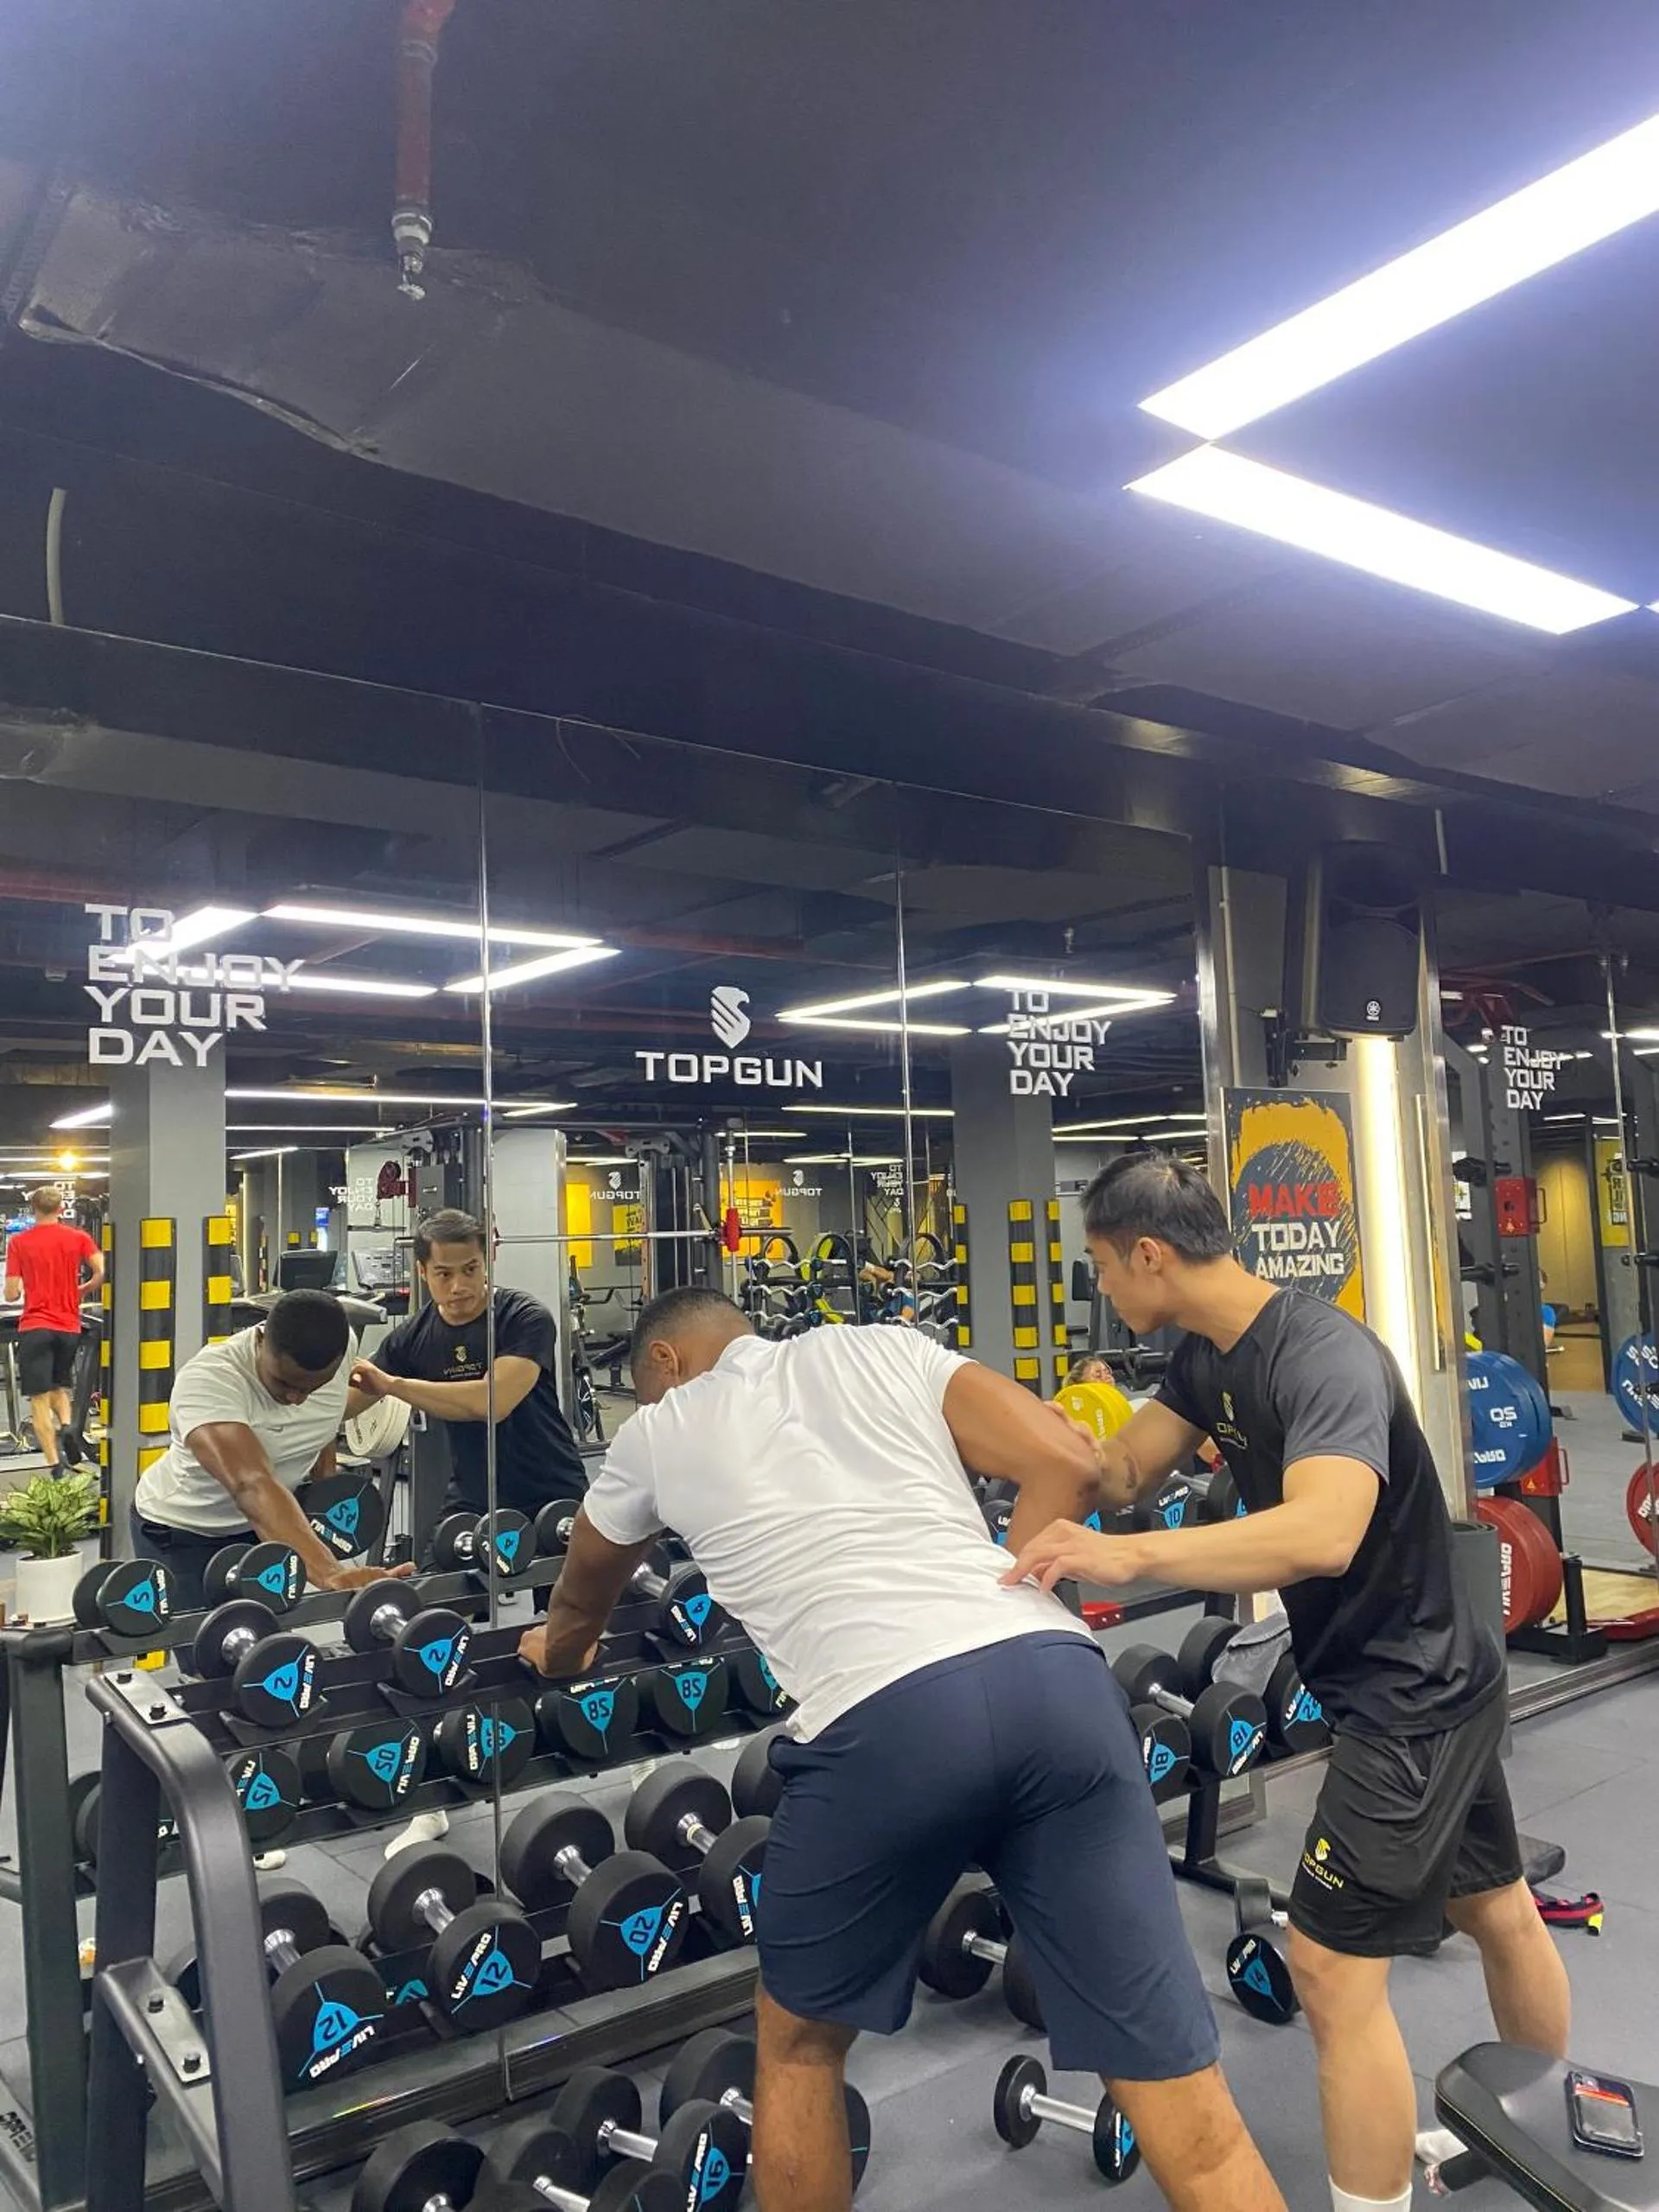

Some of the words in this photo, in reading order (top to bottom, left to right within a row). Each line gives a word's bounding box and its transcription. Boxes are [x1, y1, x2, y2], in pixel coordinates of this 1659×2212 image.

[84, 904, 174, 942] TO
[87, 944, 305, 992] ENJOY
[84, 986, 268, 1030] YOUR
[1005, 988, 1049, 1013] TO
[1007, 1014, 1112, 1045] ENJOY
[1501, 1025, 1527, 1046] TO
[88, 1027, 224, 1067] DAY
[1007, 1041, 1096, 1071] YOUR
[1503, 1046, 1562, 1071] ENJOY
[635, 1051, 823, 1089] TOPGUN
[1009, 1070, 1074, 1096] DAY
[1503, 1067, 1555, 1090] YOUR
[1506, 1089, 1544, 1110] DAY
[1249, 1181, 1341, 1217] MAKE
[1251, 1222, 1341, 1251] TODAY
[1256, 1252, 1344, 1279] AMAZING
[1304, 1853, 1344, 1889] OPGUN
[629, 1915, 655, 1944] 20
[647, 1901, 684, 1972] LIVEPRO
[451, 1932, 493, 1999] LIVEPRO
[480, 1962, 509, 1988] 12
[318, 2010, 347, 2040] 12
[309, 2025, 376, 2079] LIVEPRO
[706, 2160, 724, 2187] 16
